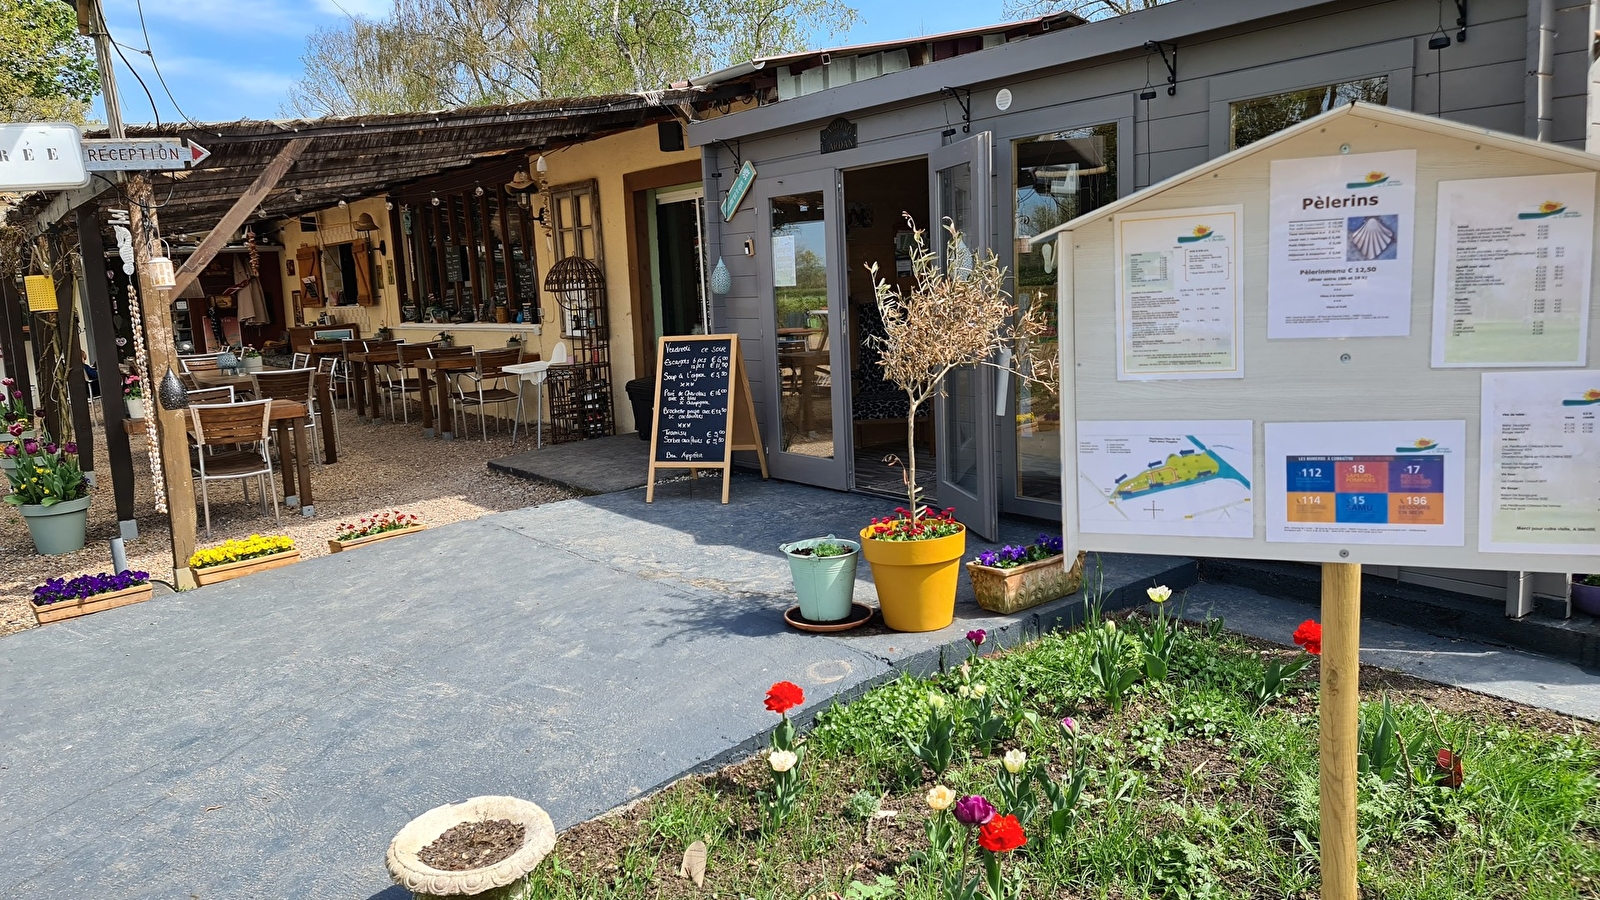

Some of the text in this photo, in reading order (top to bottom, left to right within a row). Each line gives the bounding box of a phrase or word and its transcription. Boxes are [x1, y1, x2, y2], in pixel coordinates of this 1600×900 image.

[88, 145, 180, 161] RÉCEPTION
[1302, 194, 1379, 210] Pèlerins
[1301, 468, 1322, 478] 112
[1352, 464, 1365, 474] 18
[1406, 465, 1421, 474] 17
[1302, 496, 1321, 505] 114
[1352, 495, 1365, 505] 15
[1406, 496, 1427, 505] 196
[1346, 504, 1373, 512] SAMU
